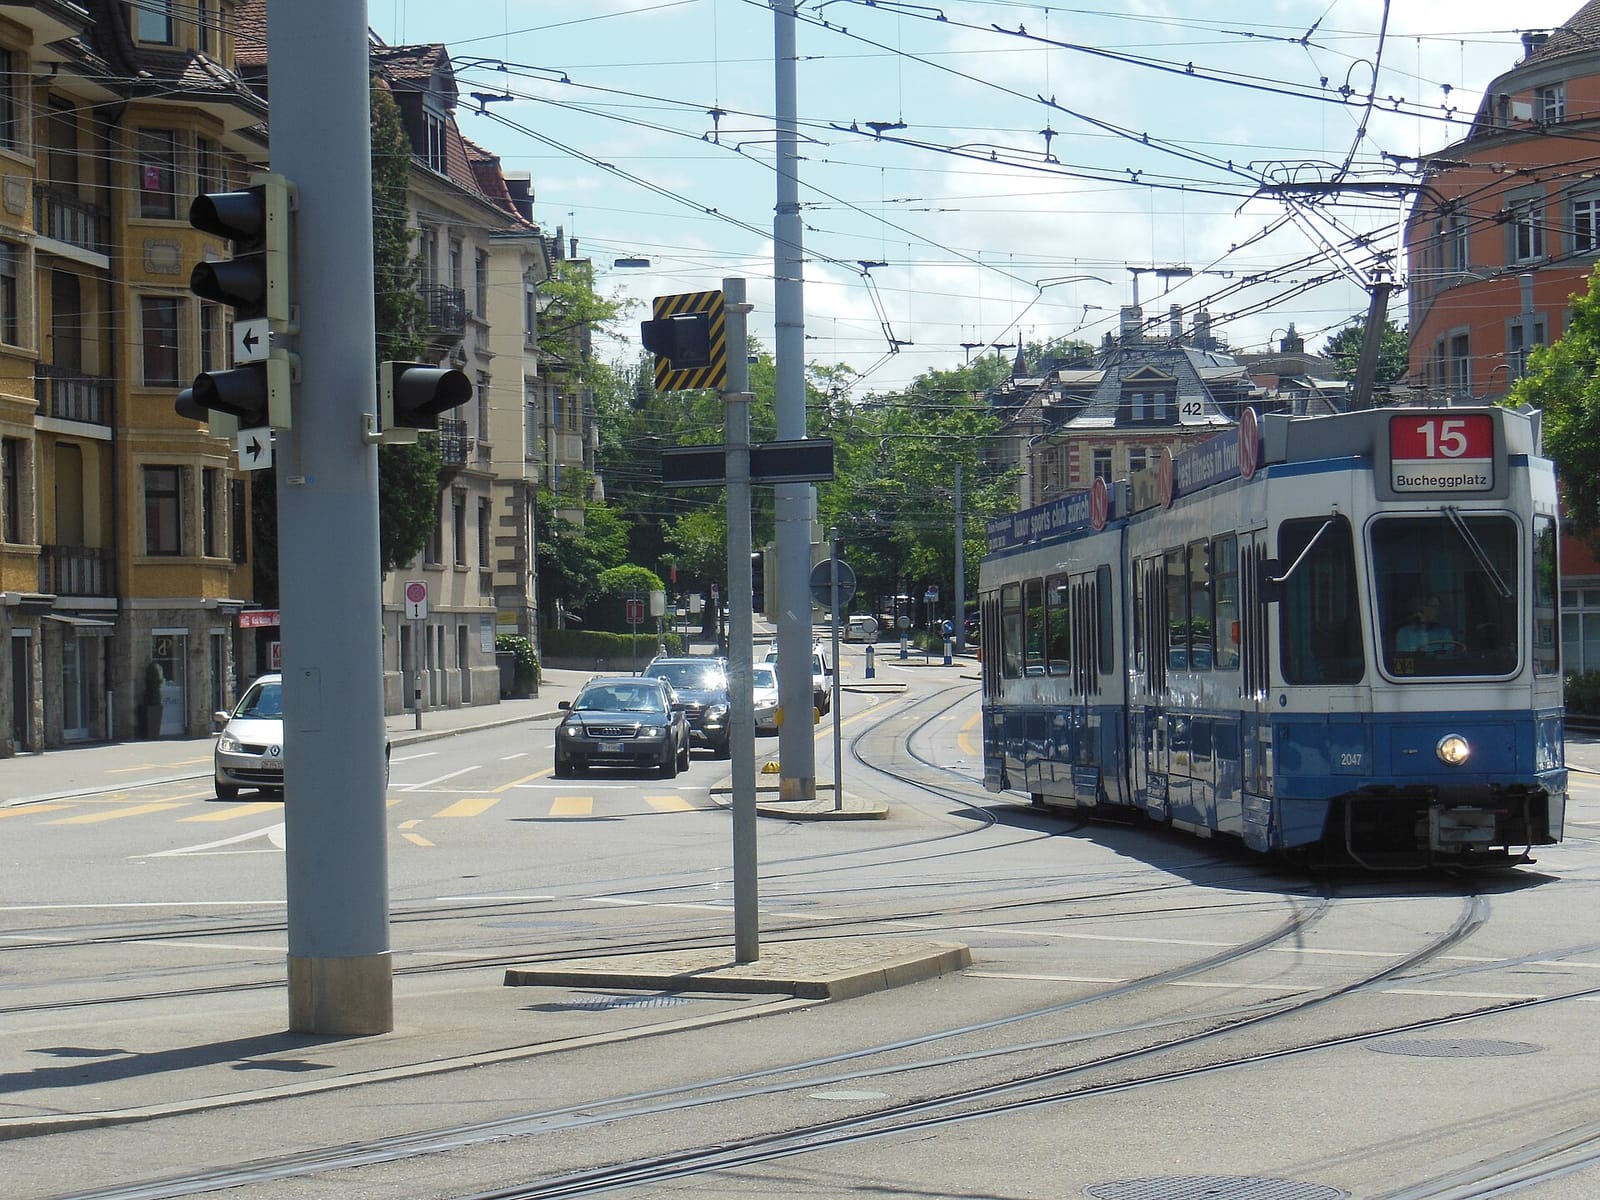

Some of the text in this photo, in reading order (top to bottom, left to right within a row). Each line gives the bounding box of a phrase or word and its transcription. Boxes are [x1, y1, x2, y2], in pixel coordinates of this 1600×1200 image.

[1182, 402, 1202, 416] 42
[1416, 420, 1468, 458] 15
[1215, 443, 1222, 474] in
[1396, 474, 1487, 488] Bucheggplatz
[1031, 507, 1050, 538] sports
[1052, 501, 1066, 529] club
[1067, 494, 1089, 524] zürich
[1341, 753, 1362, 766] 2047
